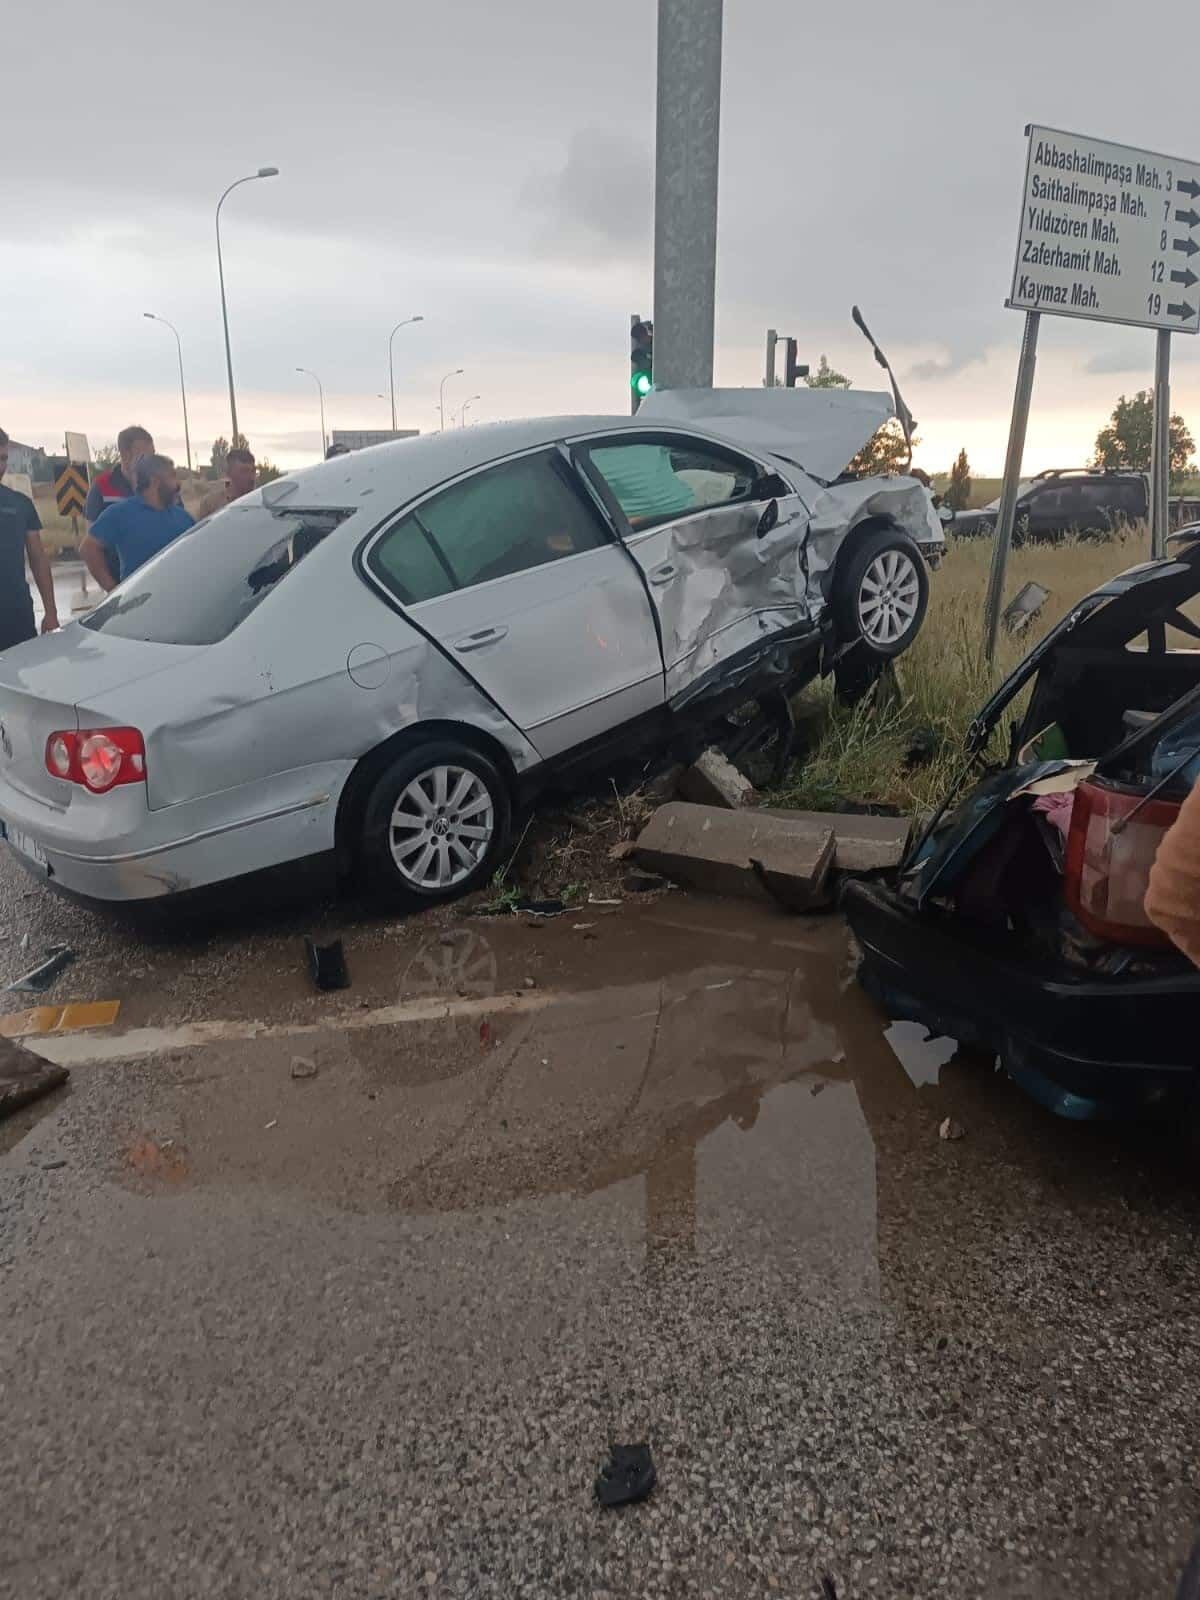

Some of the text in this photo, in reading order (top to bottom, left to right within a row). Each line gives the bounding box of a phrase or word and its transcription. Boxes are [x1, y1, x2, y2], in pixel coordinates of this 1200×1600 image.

[1034, 142, 1172, 192] Abbashalimpaşa Mah. 3
[1031, 175, 1169, 220] Saithalimpaşa Mah. 7
[1028, 208, 1167, 251] Yıldızören Mah. 8
[1022, 240, 1165, 283] Zaferhamit Mah. 12
[1018, 276, 1161, 316] Kaymaz Mah. 19
